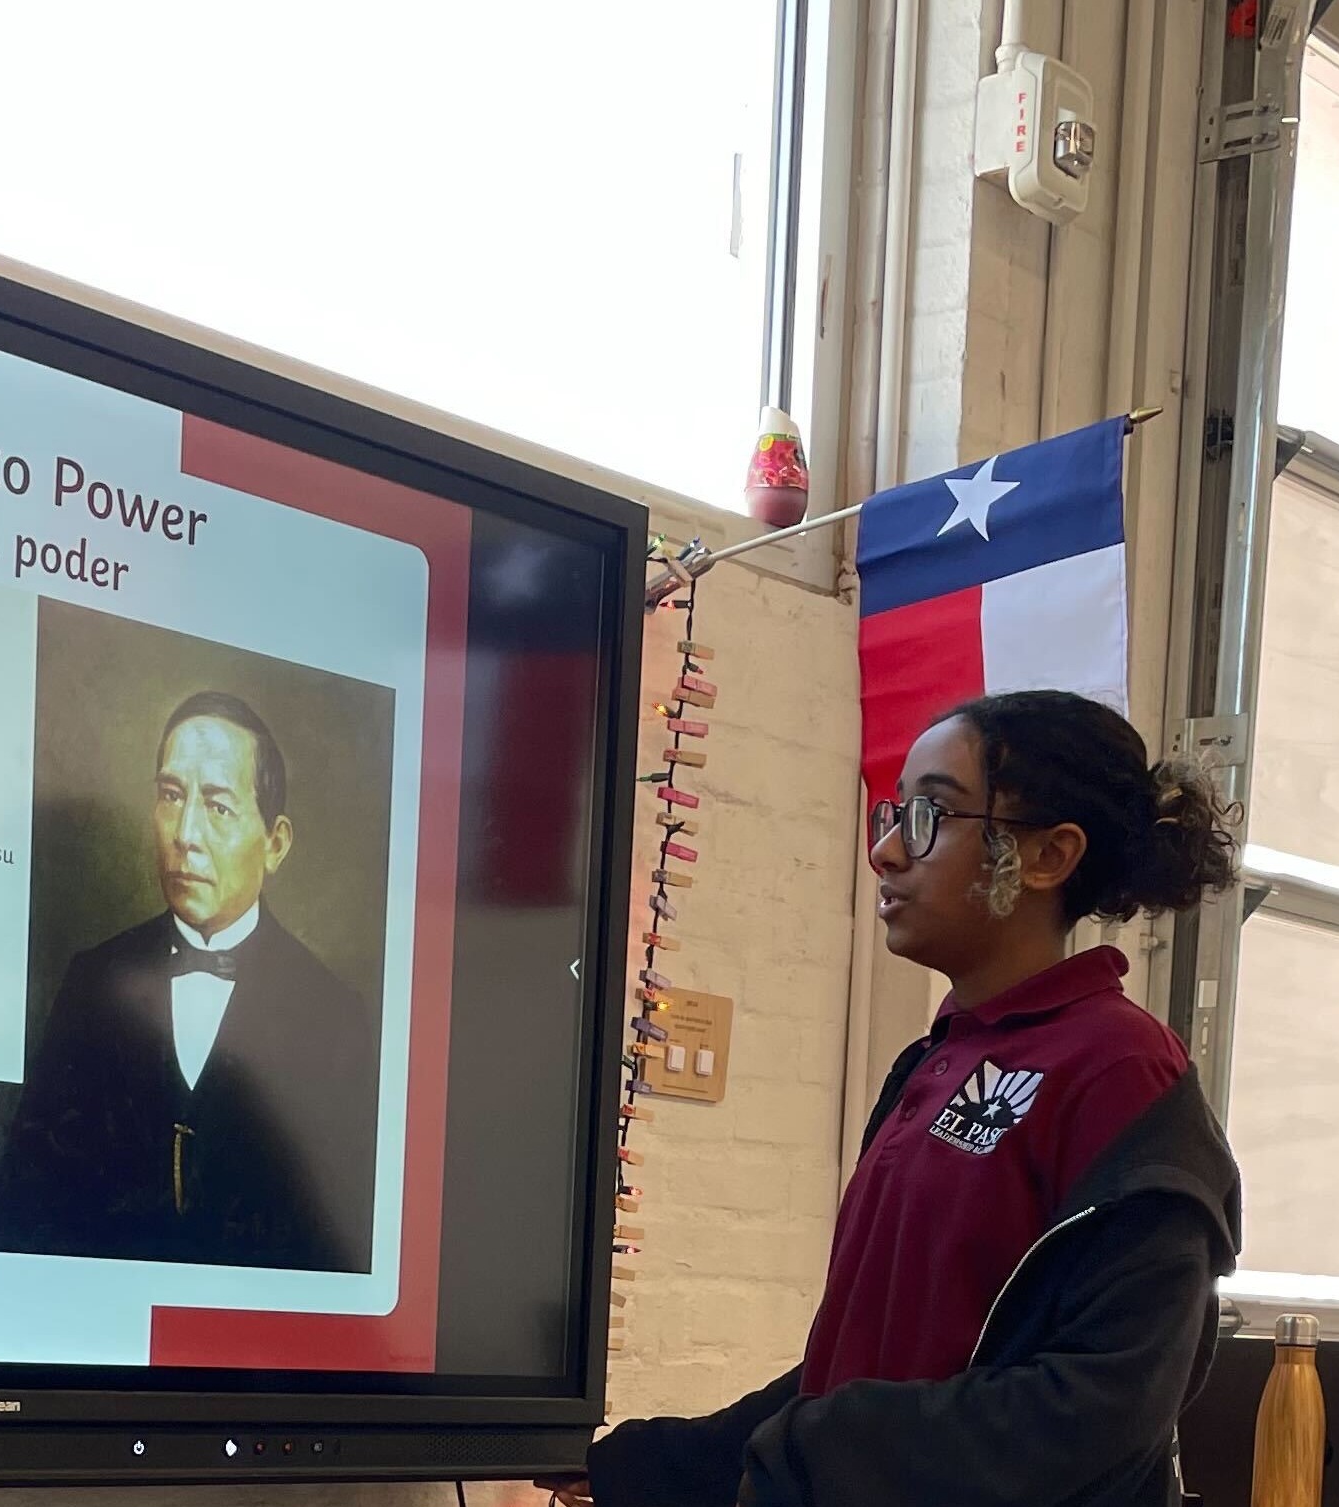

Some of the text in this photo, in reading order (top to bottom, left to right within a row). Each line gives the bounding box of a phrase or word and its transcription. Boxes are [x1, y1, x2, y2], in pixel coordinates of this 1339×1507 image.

[1015, 92, 1027, 153] FIRE
[54, 456, 208, 546] Power
[15, 534, 130, 591] poder
[934, 1108, 966, 1136] EL
